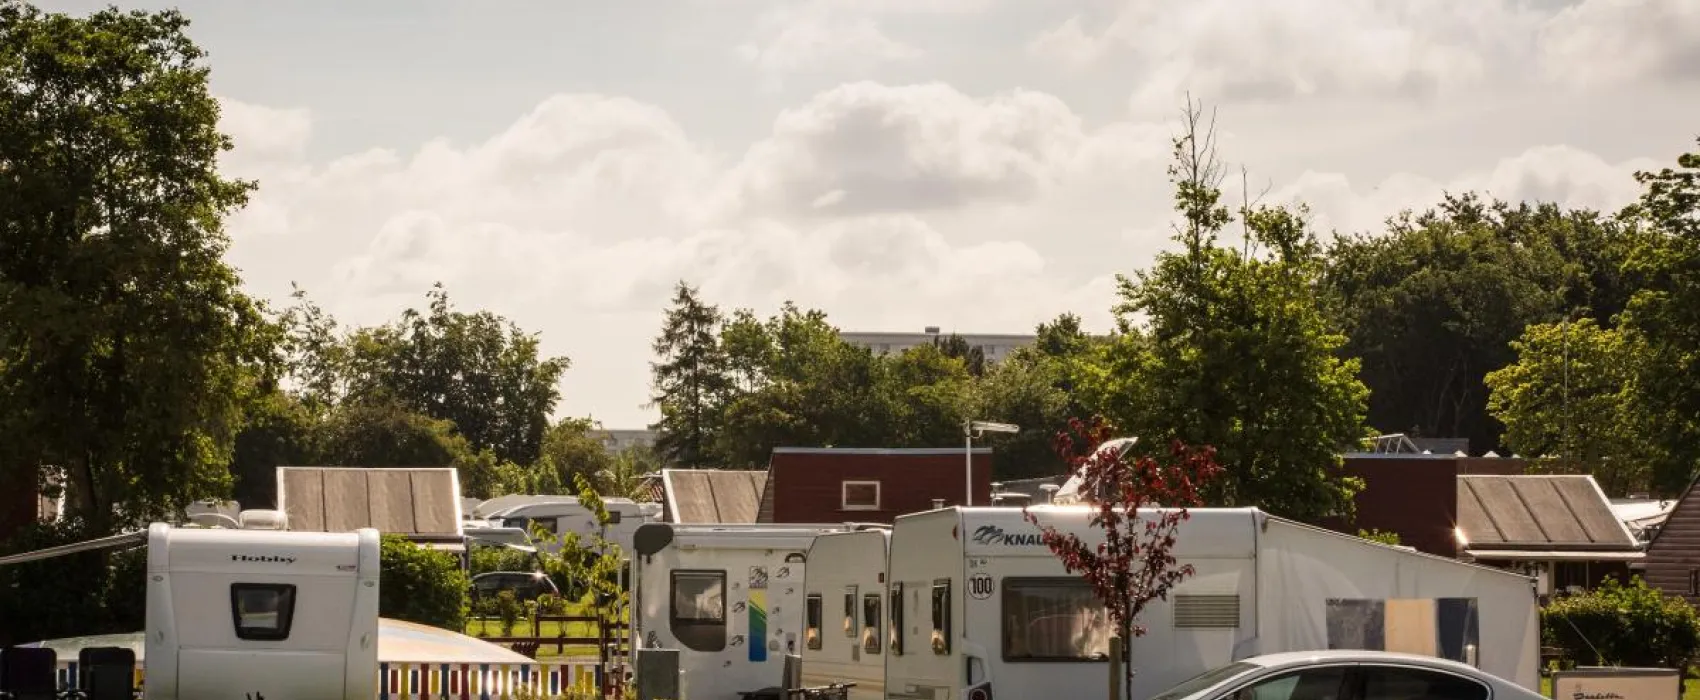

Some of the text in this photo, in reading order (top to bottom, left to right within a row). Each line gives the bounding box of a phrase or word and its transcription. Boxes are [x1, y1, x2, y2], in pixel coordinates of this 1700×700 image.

[1003, 534, 1048, 546] KNAU
[231, 555, 297, 565] Hobby
[969, 577, 992, 594] 100
